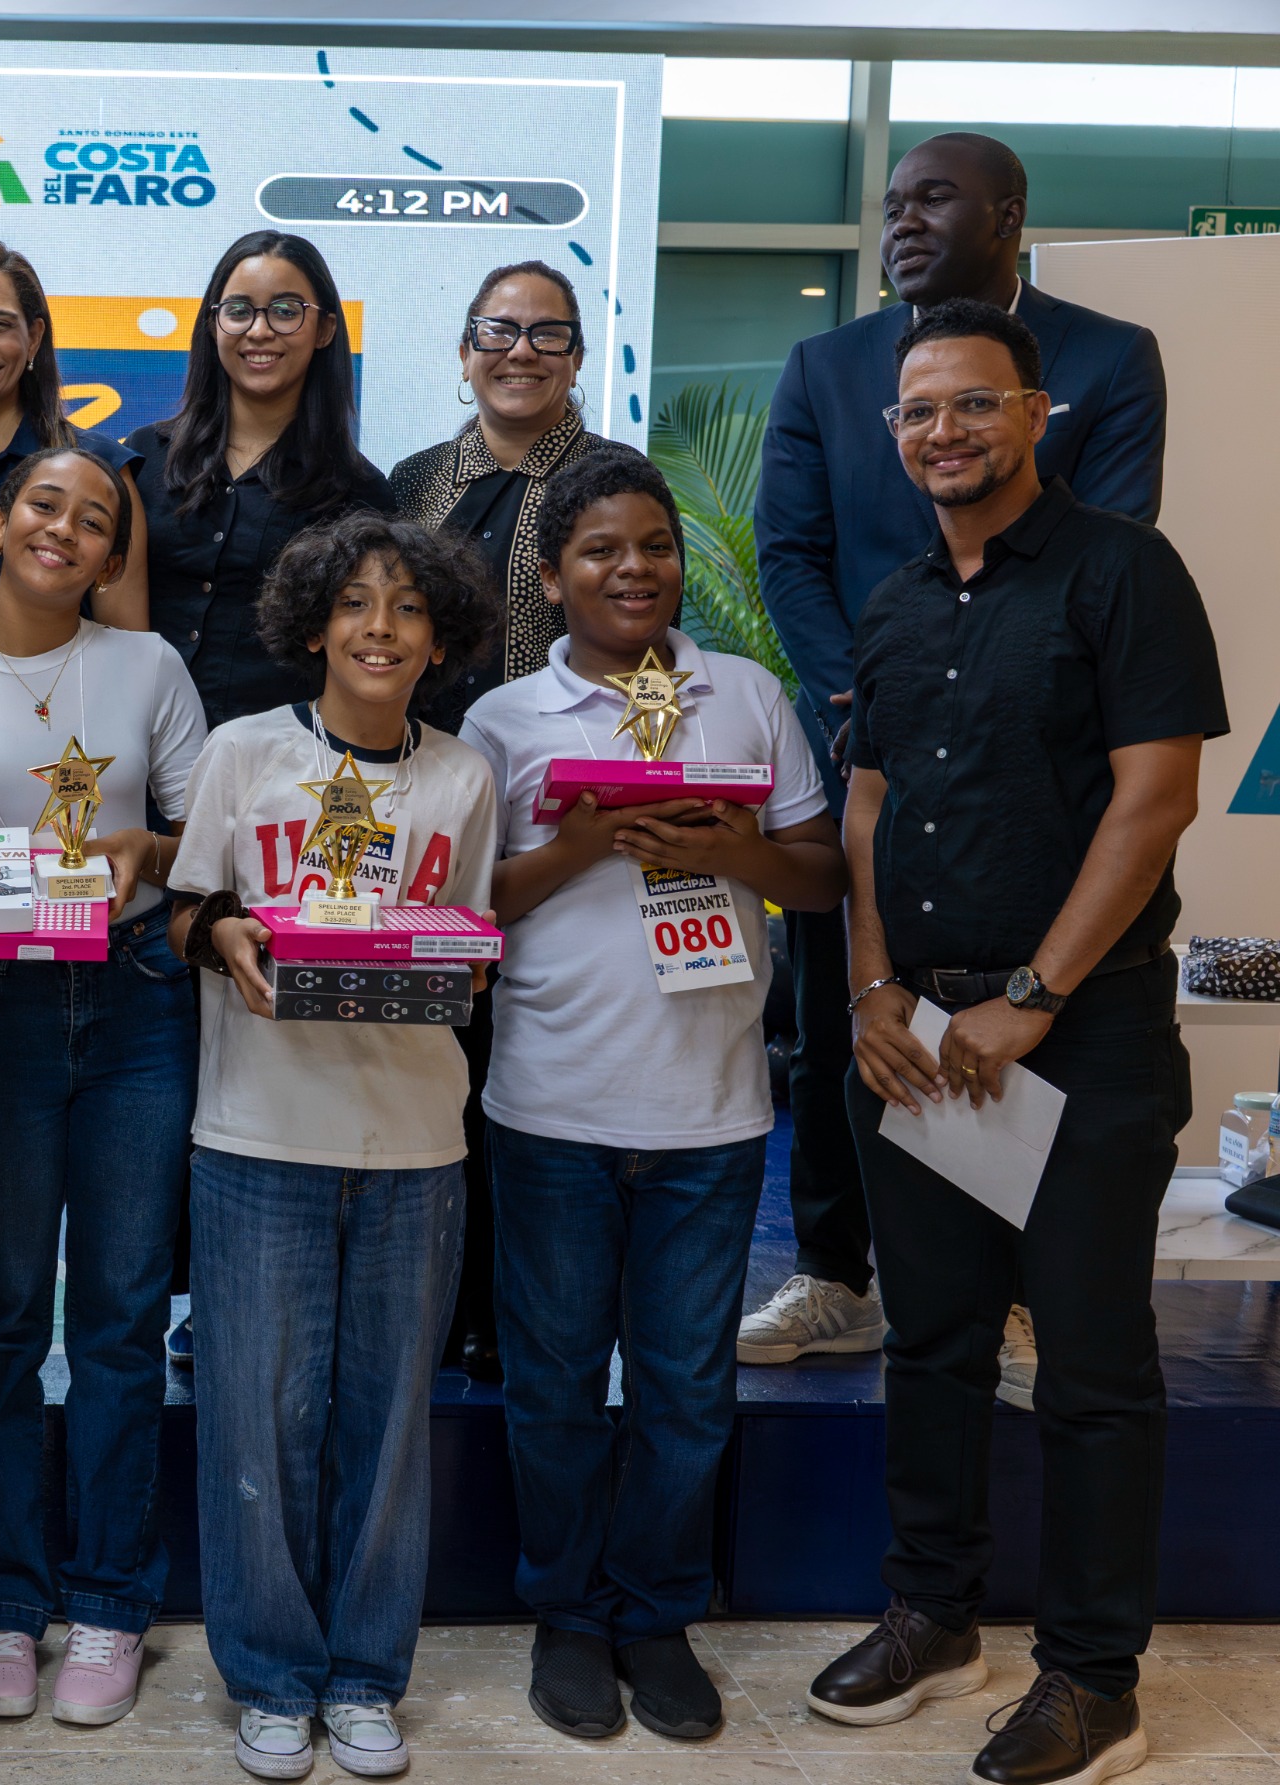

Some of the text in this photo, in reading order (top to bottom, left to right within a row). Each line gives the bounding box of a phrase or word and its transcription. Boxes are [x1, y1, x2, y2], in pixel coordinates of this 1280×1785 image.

[59, 129, 100, 137] SANTO
[105, 130, 165, 138] DOMINGO
[44, 142, 211, 172] COSTA
[44, 174, 61, 204] DEL
[65, 174, 216, 207] FARO
[336, 189, 508, 216] 4:12 PM
[636, 692, 666, 701] PROA
[58, 784, 88, 793] PROA
[329, 804, 361, 814] PROA
[372, 833, 391, 844] Bee
[649, 877, 714, 894] MUNICIPAL
[640, 893, 730, 919] PARTICIPANTE
[654, 914, 733, 956] 080
[685, 957, 716, 970] PROA
